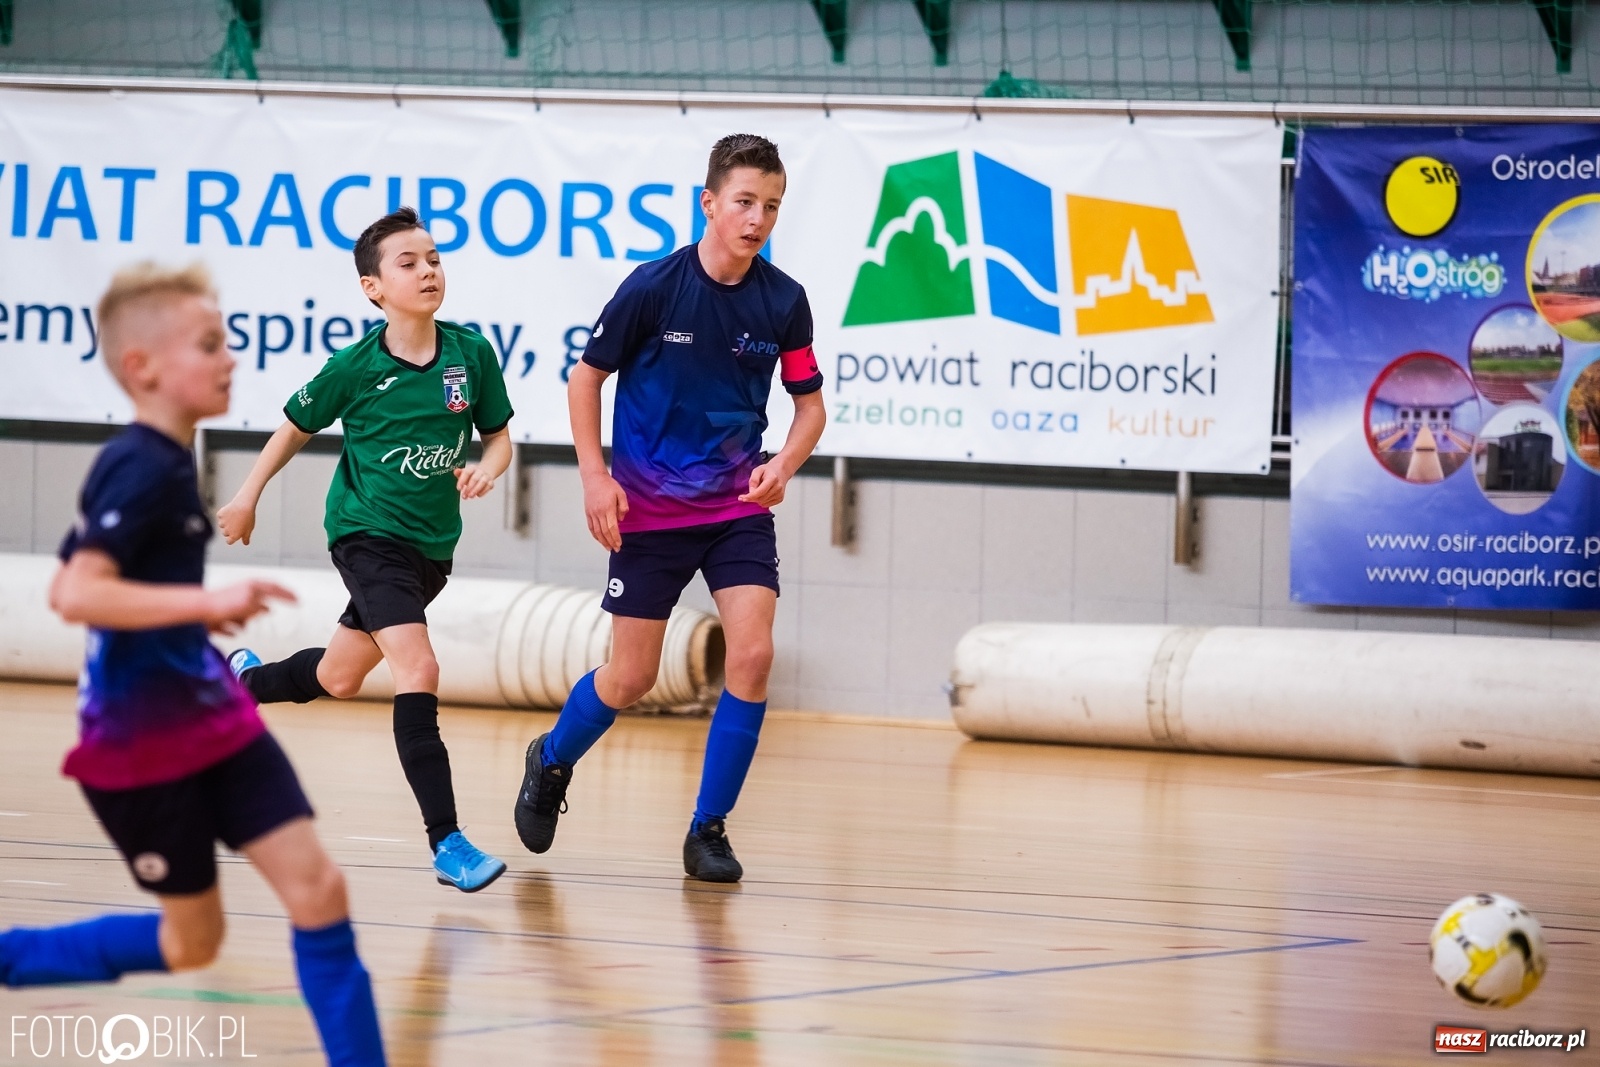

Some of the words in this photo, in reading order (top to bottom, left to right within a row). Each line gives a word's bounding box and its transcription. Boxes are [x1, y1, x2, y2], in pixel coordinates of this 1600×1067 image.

[0, 163, 156, 242] IAT
[836, 345, 981, 393] powiat
[1011, 350, 1217, 395] raciborski
[833, 398, 963, 428] zielona
[992, 409, 1079, 433] oaza
[1109, 408, 1215, 437] kultur
